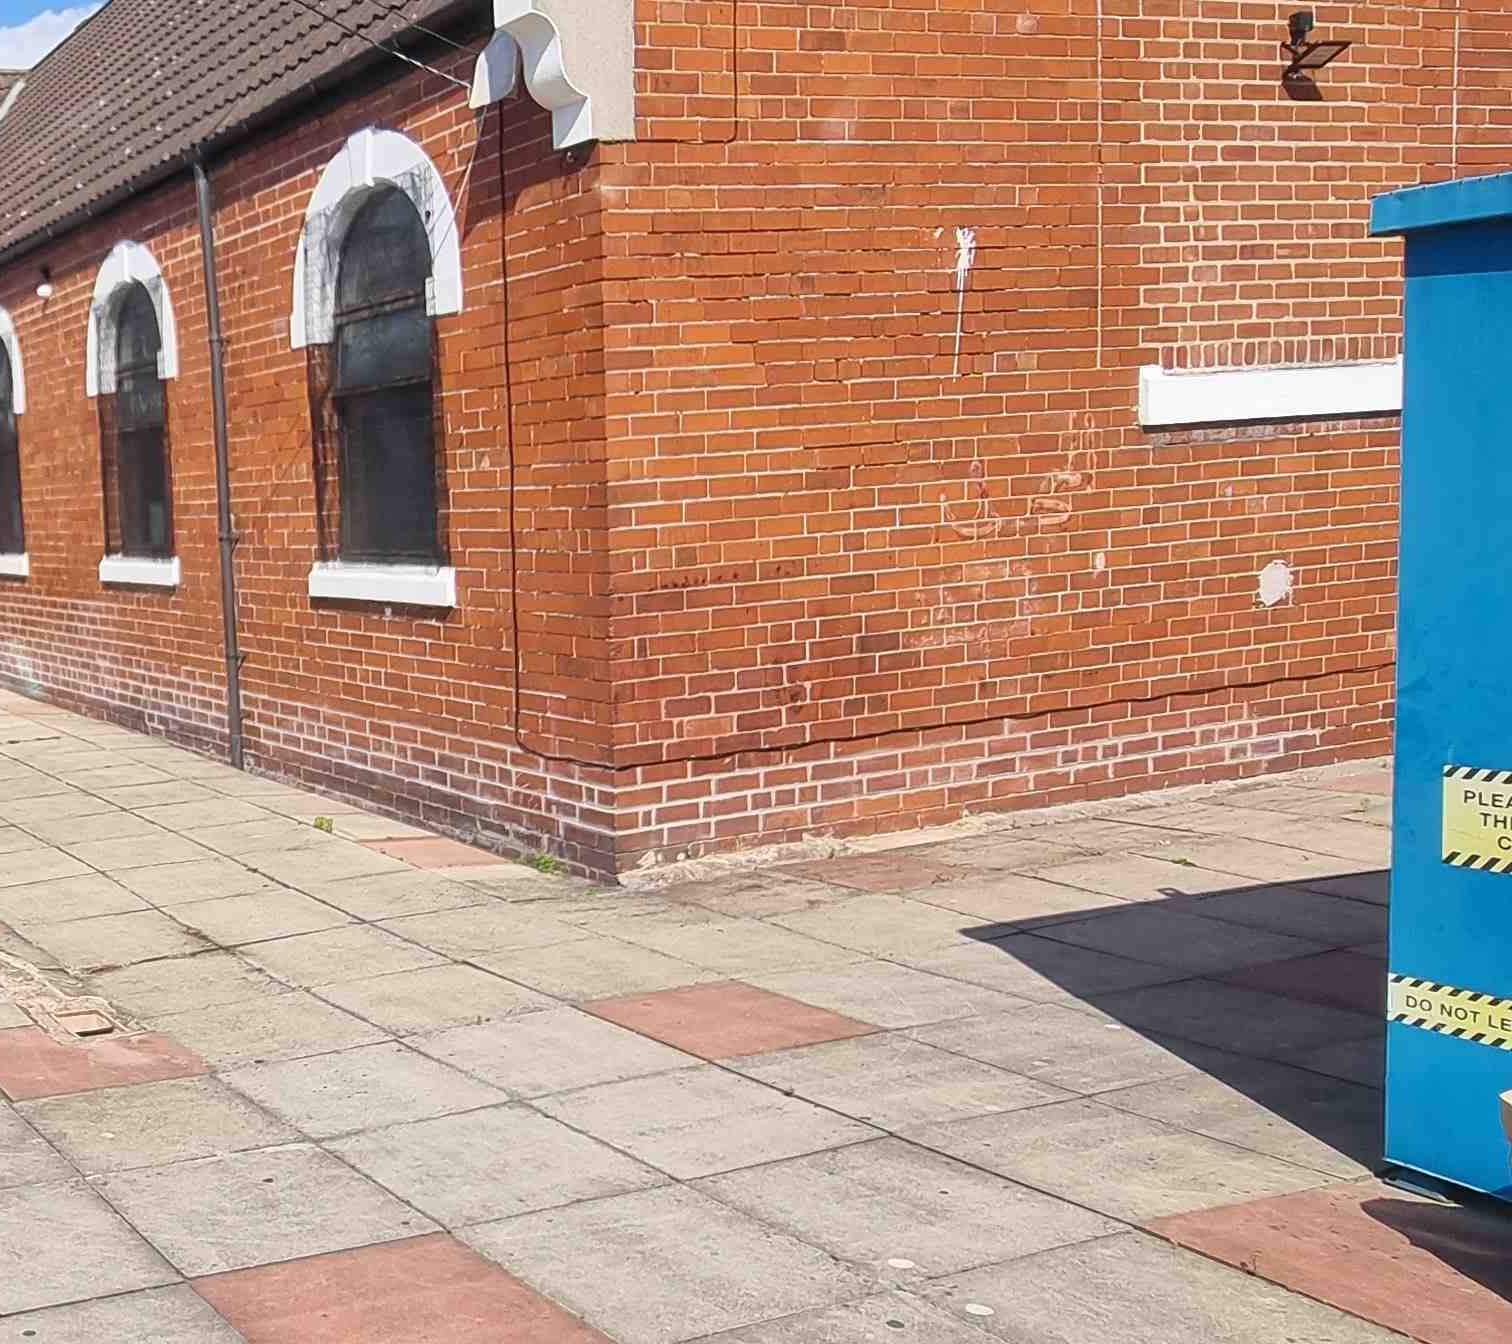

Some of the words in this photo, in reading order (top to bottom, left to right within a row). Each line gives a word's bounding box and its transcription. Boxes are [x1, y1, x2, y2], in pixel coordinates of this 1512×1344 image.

[1479, 812, 1512, 831] TH
[1406, 995, 1432, 1012] DO
[1439, 1003, 1481, 1024] NOT
